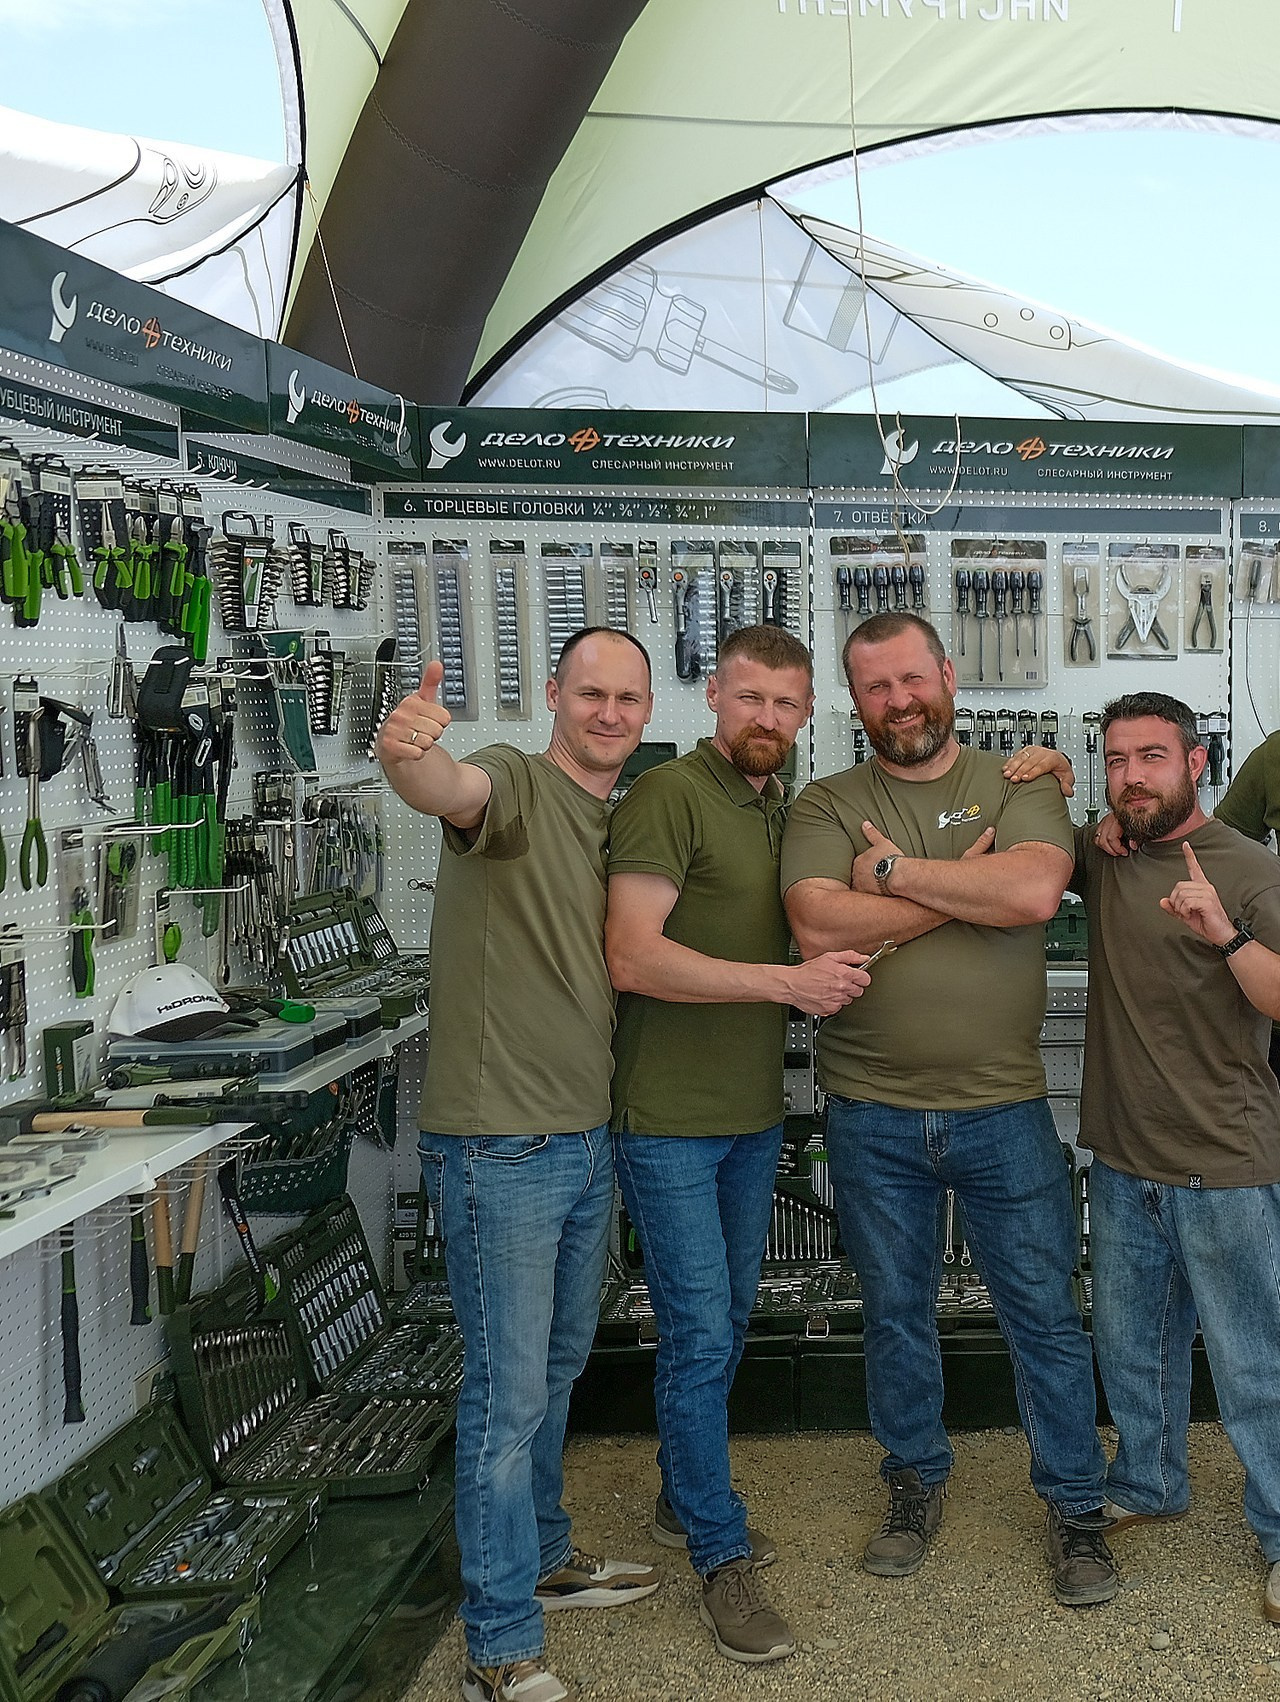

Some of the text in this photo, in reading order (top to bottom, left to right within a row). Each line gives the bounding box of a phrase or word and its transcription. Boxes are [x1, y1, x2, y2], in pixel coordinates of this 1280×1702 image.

[56, 403, 122, 436] ИНСТРУМЕНТ
[208, 454, 238, 475] КЛЮЧИ
[478, 458, 561, 469] WWW.DELOT.RU
[592, 459, 734, 472] СЛЕСАРНЫЙ ИНСТРУМЕНТ
[928, 465, 1008, 476] WWW.DELOT.RU
[1037, 467, 1173, 481] СЛЕСАРНЫЙ ИНСТРУМЕНТ
[404, 500, 417, 513] 6.
[425, 499, 509, 516] ТОРЦЕВЫЕ
[513, 501, 585, 516] ГОЛОВКИ
[833, 510, 845, 524] 7.
[1258, 521, 1271, 534] 8.
